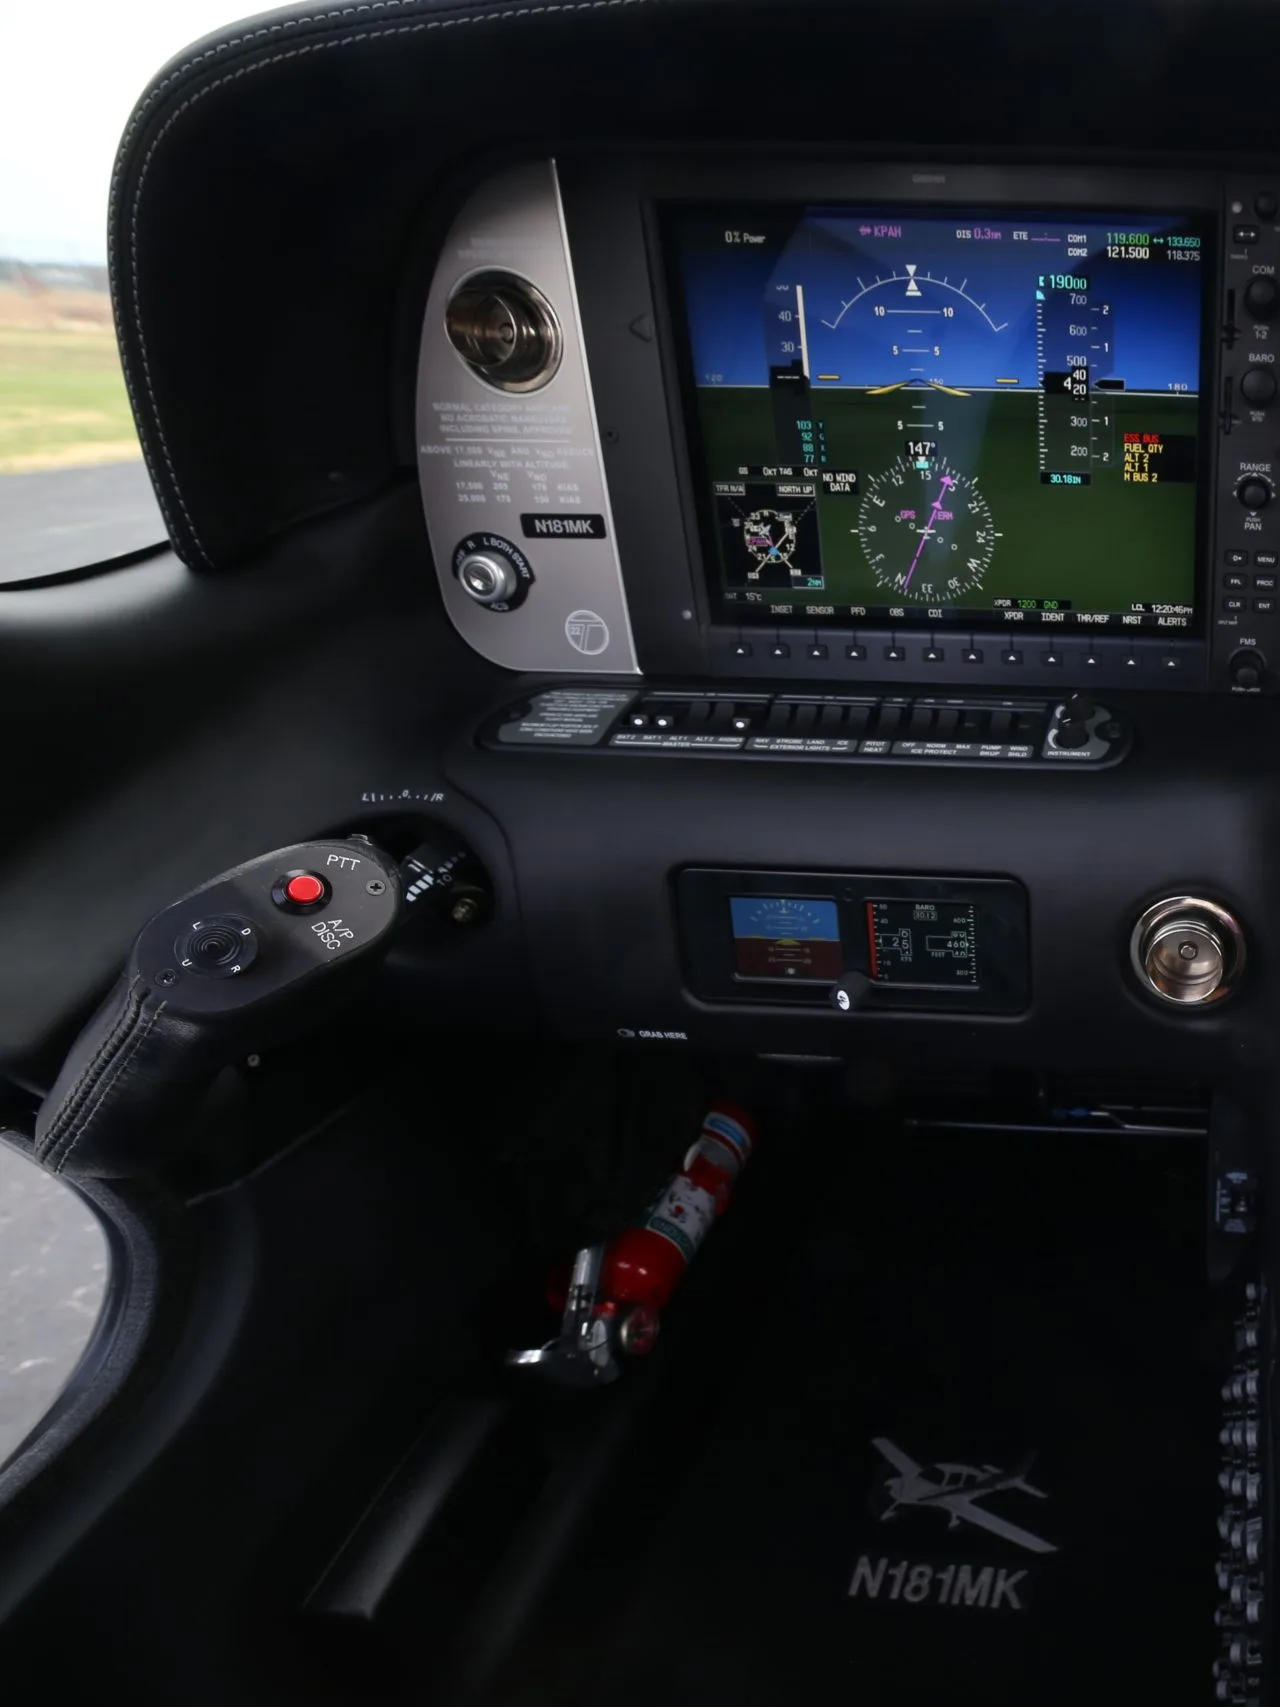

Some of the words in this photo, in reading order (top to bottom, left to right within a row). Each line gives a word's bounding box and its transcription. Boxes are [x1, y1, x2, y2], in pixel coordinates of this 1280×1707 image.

[874, 226, 901, 238] KPAH
[956, 230, 971, 239] DIS
[1013, 232, 1028, 240] ETE
[743, 234, 765, 244] Power
[1068, 235, 1086, 243] COM1
[1107, 233, 1149, 245] 119.600
[1068, 248, 1087, 256] COM2
[1107, 247, 1149, 259] 121.500
[1168, 251, 1200, 261] 118.375
[1252, 265, 1274, 274] COM
[1050, 275, 1087, 289] 19000
[1070, 294, 1087, 304] 700
[1070, 326, 1087, 335] 600
[1067, 356, 1086, 366] 500
[1249, 353, 1274, 363] BARO
[1071, 417, 1087, 427] 300
[1071, 446, 1087, 456] 200
[1124, 444, 1145, 453] FUEL
[1148, 445, 1163, 453] QTY
[1124, 454, 1139, 462] ALT
[1143, 454, 1148, 462] 2
[1124, 463, 1139, 471] ALT
[1240, 463, 1271, 472] RANGE
[823, 473, 833, 482] NO
[836, 474, 856, 483] WIND
[831, 483, 850, 491] DATA
[535, 520, 593, 534] N181MK
[1244, 523, 1262, 531] PAN
[512, 553, 530, 579] START
[771, 606, 792, 614] INSET
[806, 606, 834, 614] SENSOR
[890, 608, 904, 617] OBS
[1005, 612, 1023, 620] XPDR
[1042, 613, 1064, 621] IDENT
[1123, 615, 1141, 624] NRST
[1158, 617, 1186, 626] ALERTS
[327, 854, 360, 870] PTT
[328, 918, 354, 941] A/P
[311, 921, 340, 950] DISC
[848, 1556, 1029, 1609] N181MK
